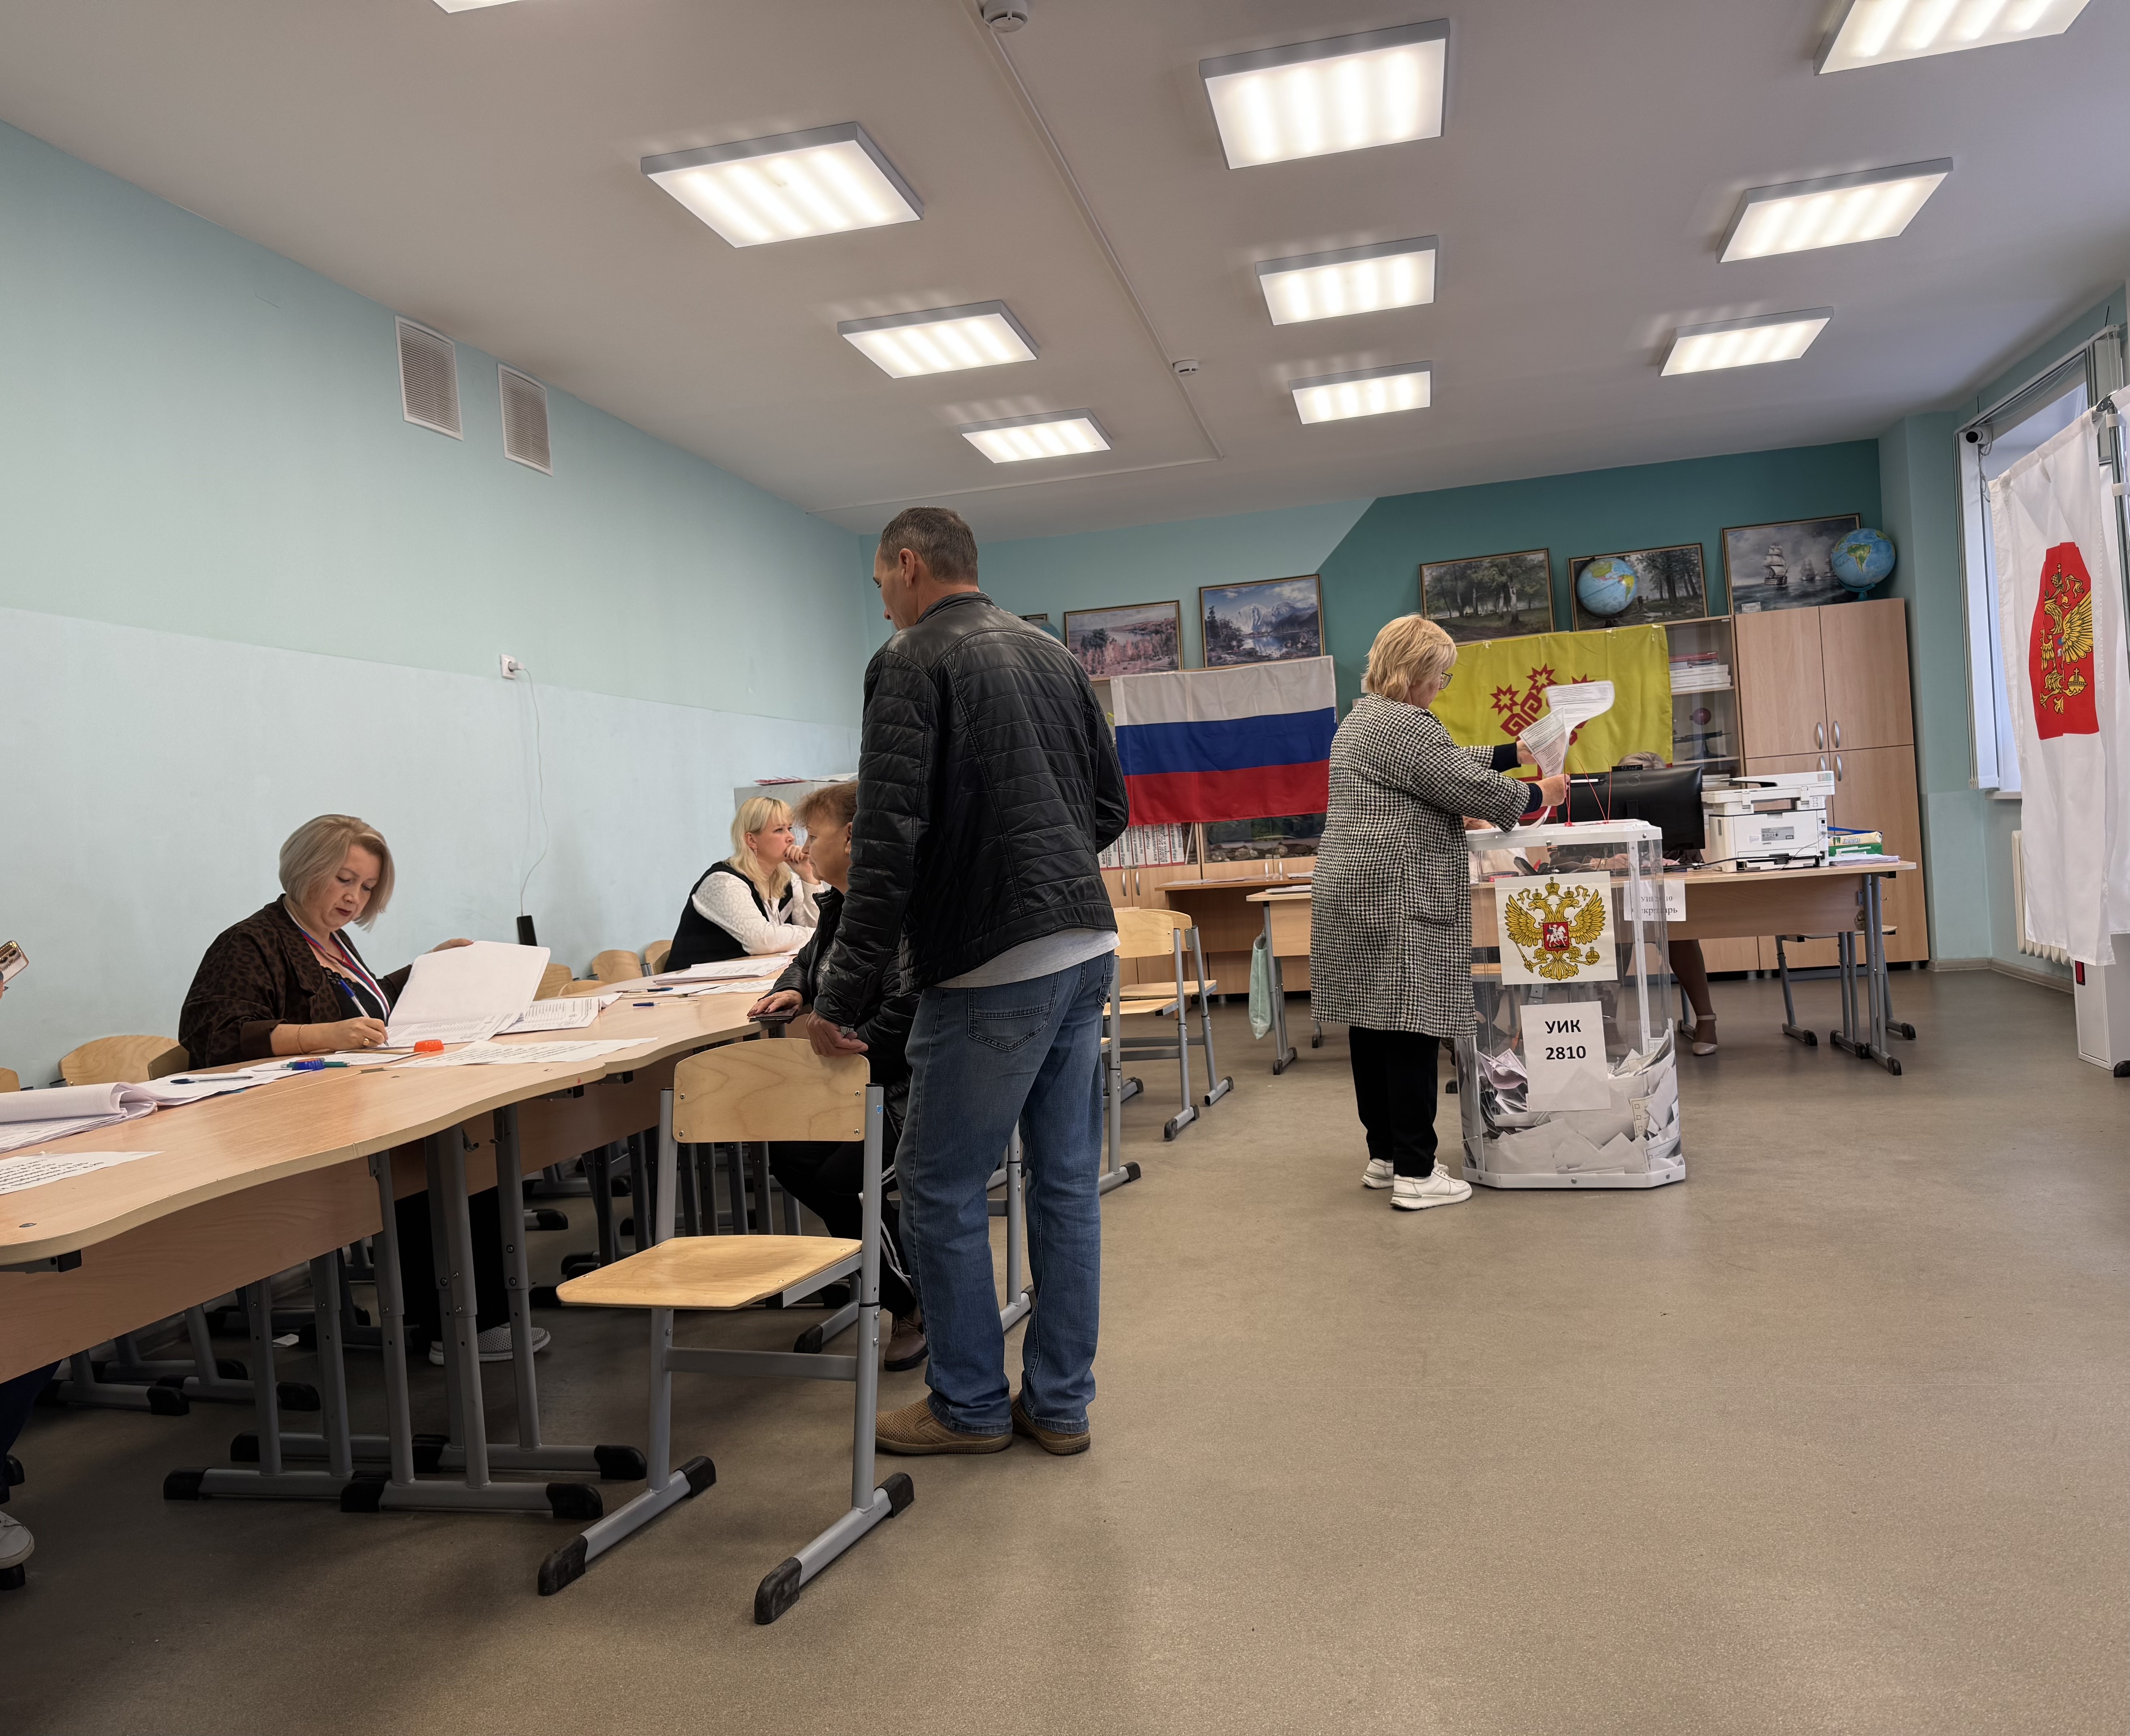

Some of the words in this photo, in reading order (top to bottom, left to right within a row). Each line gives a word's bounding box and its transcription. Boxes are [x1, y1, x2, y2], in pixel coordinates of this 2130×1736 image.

[1625, 773, 1641, 787] 3
[1545, 1019, 1582, 1034] УИК
[1545, 1045, 1586, 1060] 2810
